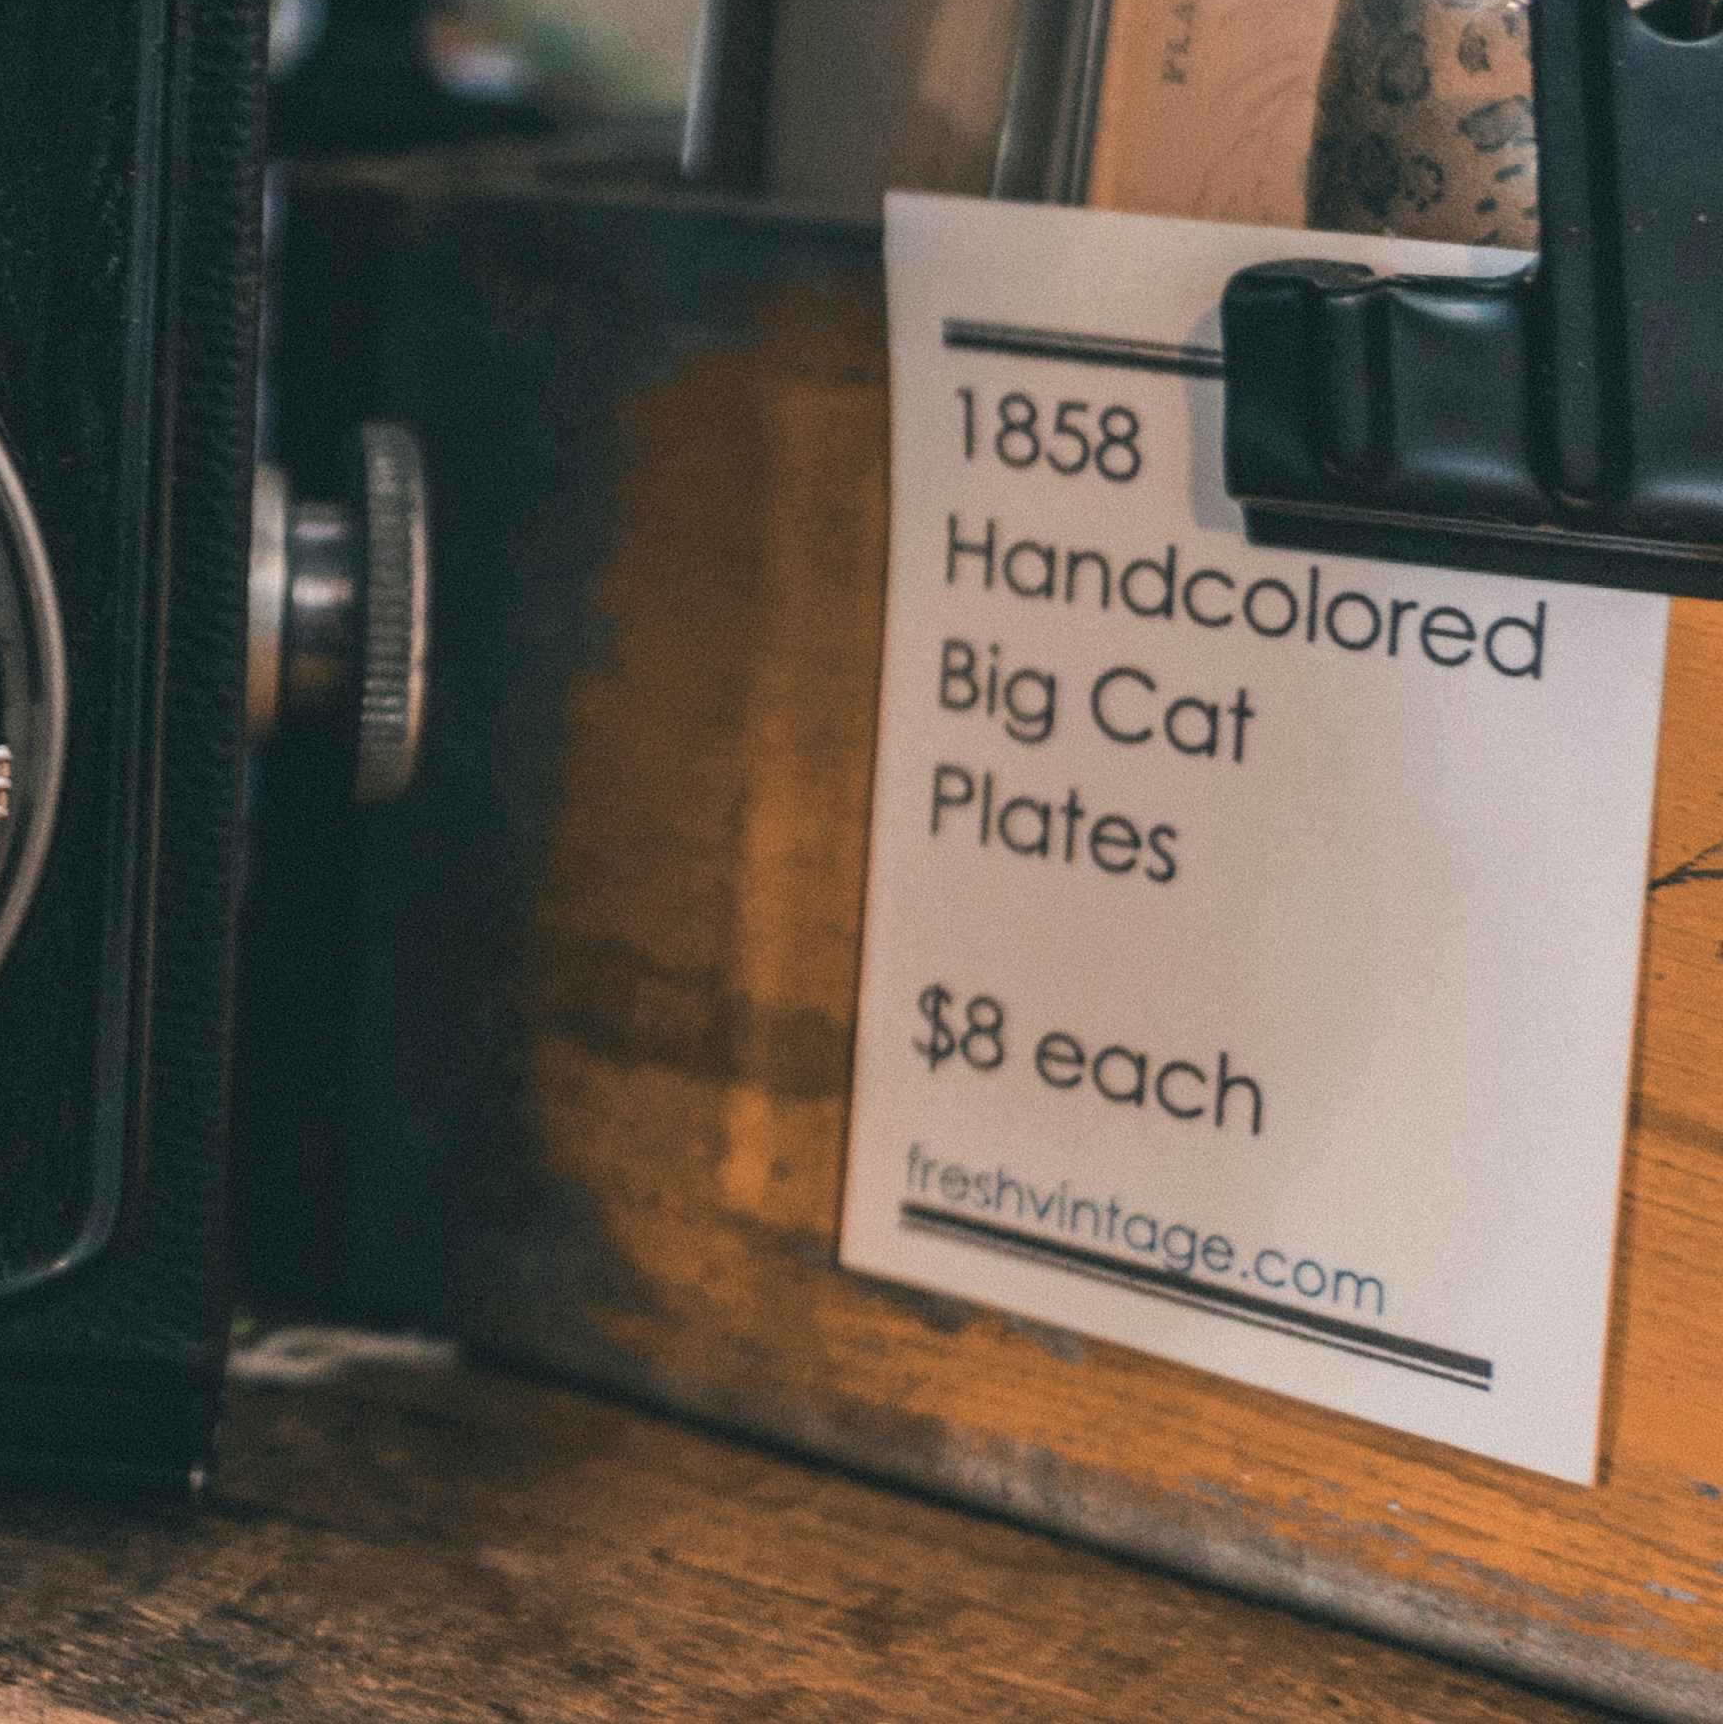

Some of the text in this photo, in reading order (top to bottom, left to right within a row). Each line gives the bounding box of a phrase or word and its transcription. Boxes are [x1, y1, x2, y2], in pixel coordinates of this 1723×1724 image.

[956, 386, 1144, 486] 1858
[944, 512, 1549, 682] Handcolored
[938, 636, 1257, 765] Big Cat
[929, 761, 1179, 886] Plates
[913, 980, 1265, 1138] $8 each
[905, 1141, 1387, 1316] freshvintage.com
